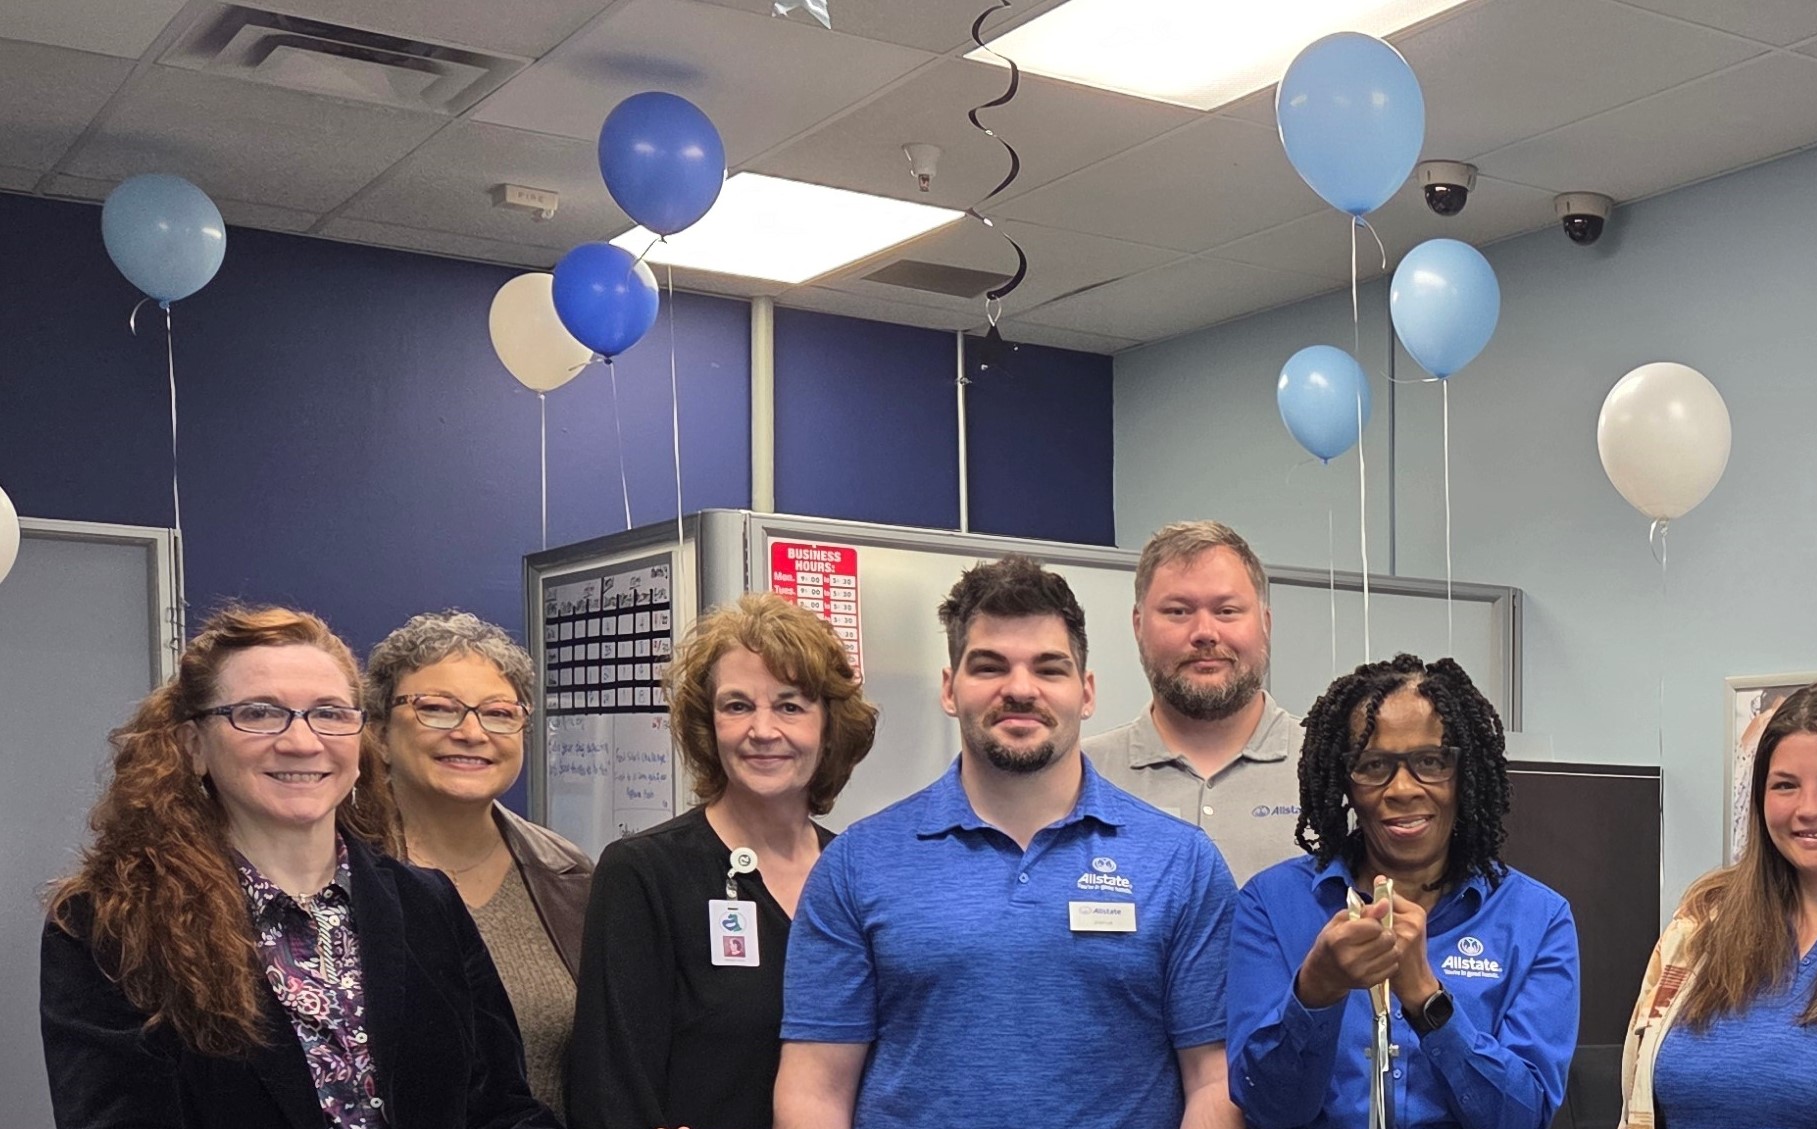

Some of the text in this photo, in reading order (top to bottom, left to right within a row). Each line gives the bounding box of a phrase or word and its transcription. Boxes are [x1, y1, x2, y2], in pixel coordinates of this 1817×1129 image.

[787, 547, 842, 563] BUSINESS
[795, 560, 836, 573] HOURS:
[773, 571, 796, 582] Mon.
[773, 585, 796, 595] Tues.
[1271, 805, 1301, 816] Allsta
[1077, 873, 1130, 887] Allstate
[1093, 907, 1121, 916] Allstate
[1441, 955, 1500, 972] Allstate
